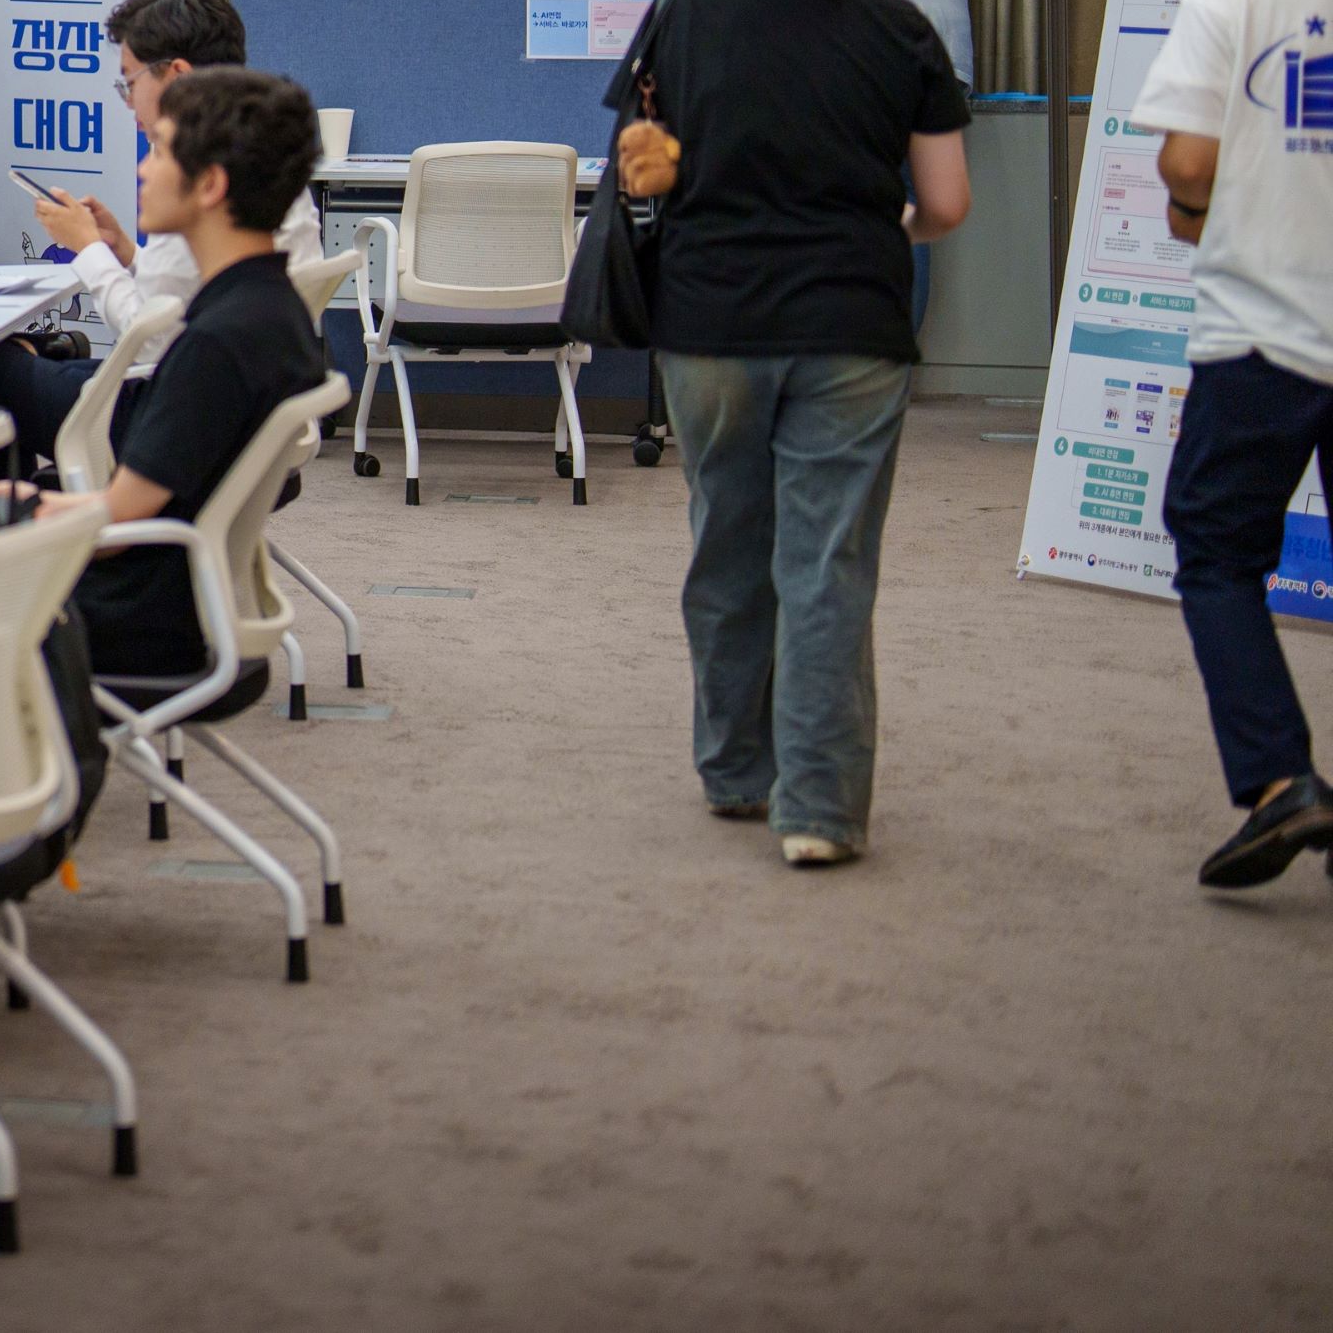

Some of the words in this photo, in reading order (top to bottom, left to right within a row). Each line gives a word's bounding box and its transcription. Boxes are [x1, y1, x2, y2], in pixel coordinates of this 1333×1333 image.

[10, 18, 105, 74] 정장
[12, 97, 104, 154] 대여
[1108, 120, 1115, 132] 2
[1082, 287, 1089, 298] 3
[1057, 440, 1064, 452] 4
